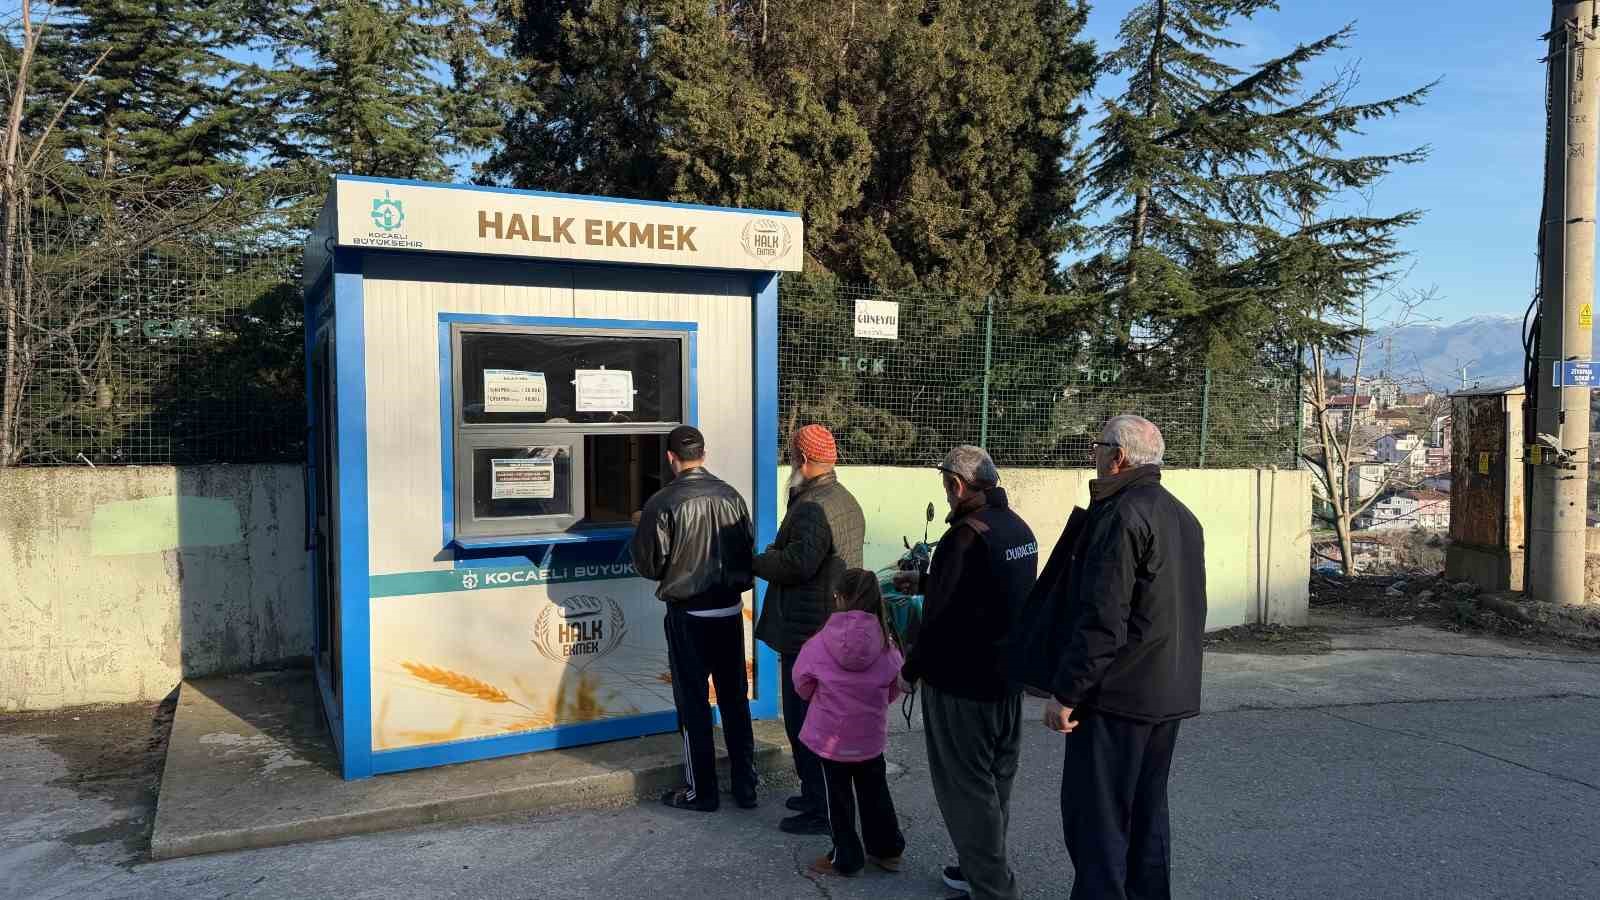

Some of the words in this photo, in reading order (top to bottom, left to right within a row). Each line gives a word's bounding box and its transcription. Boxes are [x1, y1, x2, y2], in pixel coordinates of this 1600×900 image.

[478, 210, 576, 245] HALK
[585, 219, 698, 252] EKMEK
[754, 234, 779, 248] HALK
[837, 356, 885, 374] TCK
[574, 562, 634, 577] BÜYÜK
[558, 620, 603, 643] HALK
[563, 641, 599, 657] EKMEK
